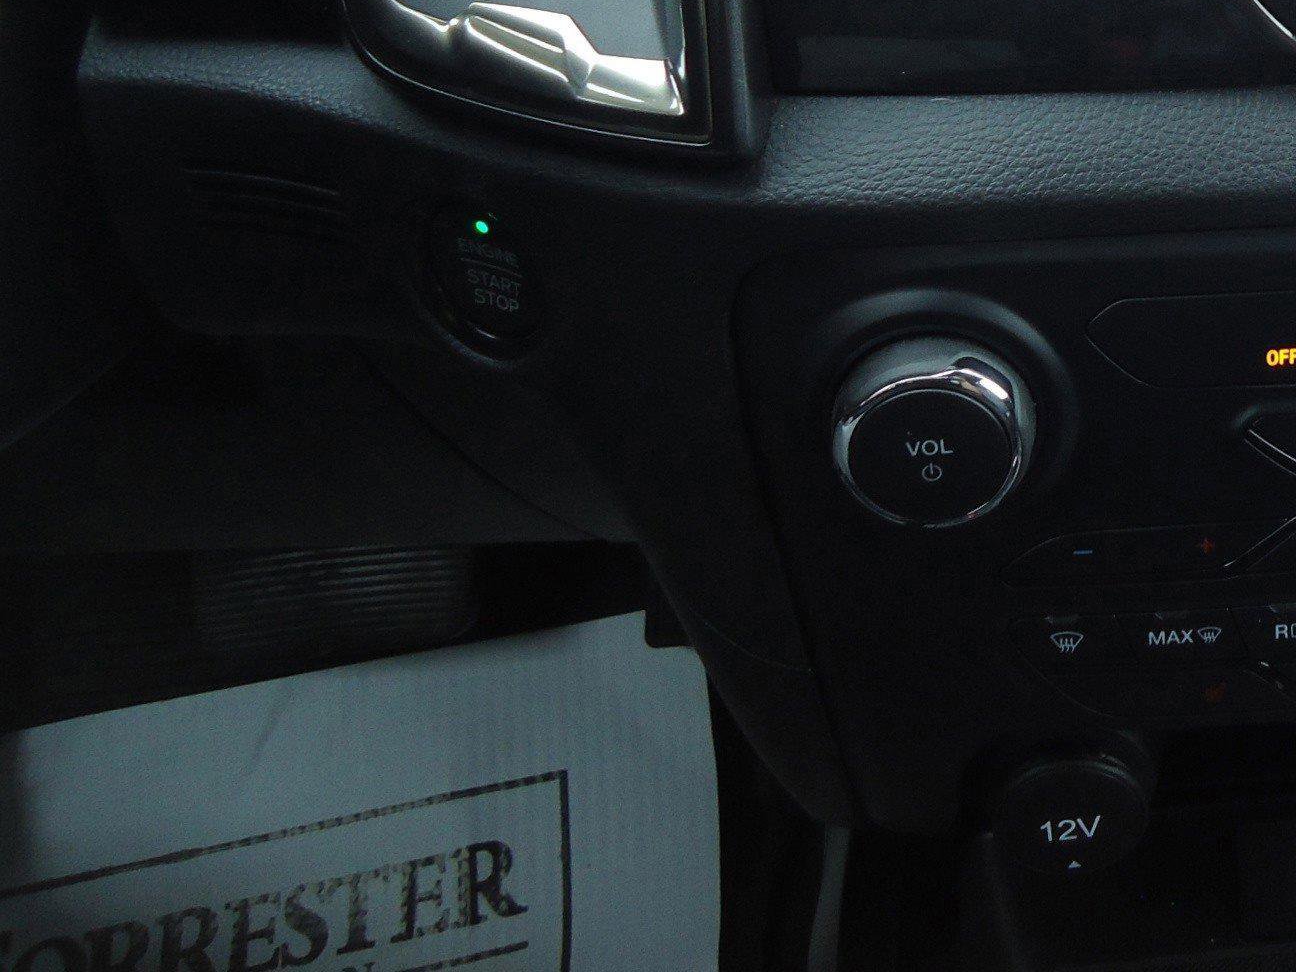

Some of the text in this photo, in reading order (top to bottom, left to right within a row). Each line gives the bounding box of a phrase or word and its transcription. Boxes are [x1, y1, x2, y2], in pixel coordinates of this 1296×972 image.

[473, 287, 520, 313] STOP
[905, 438, 954, 457] VOL
[1148, 628, 1195, 647] MAX
[1274, 624, 1289, 640] R
[1040, 814, 1101, 843] 12V
